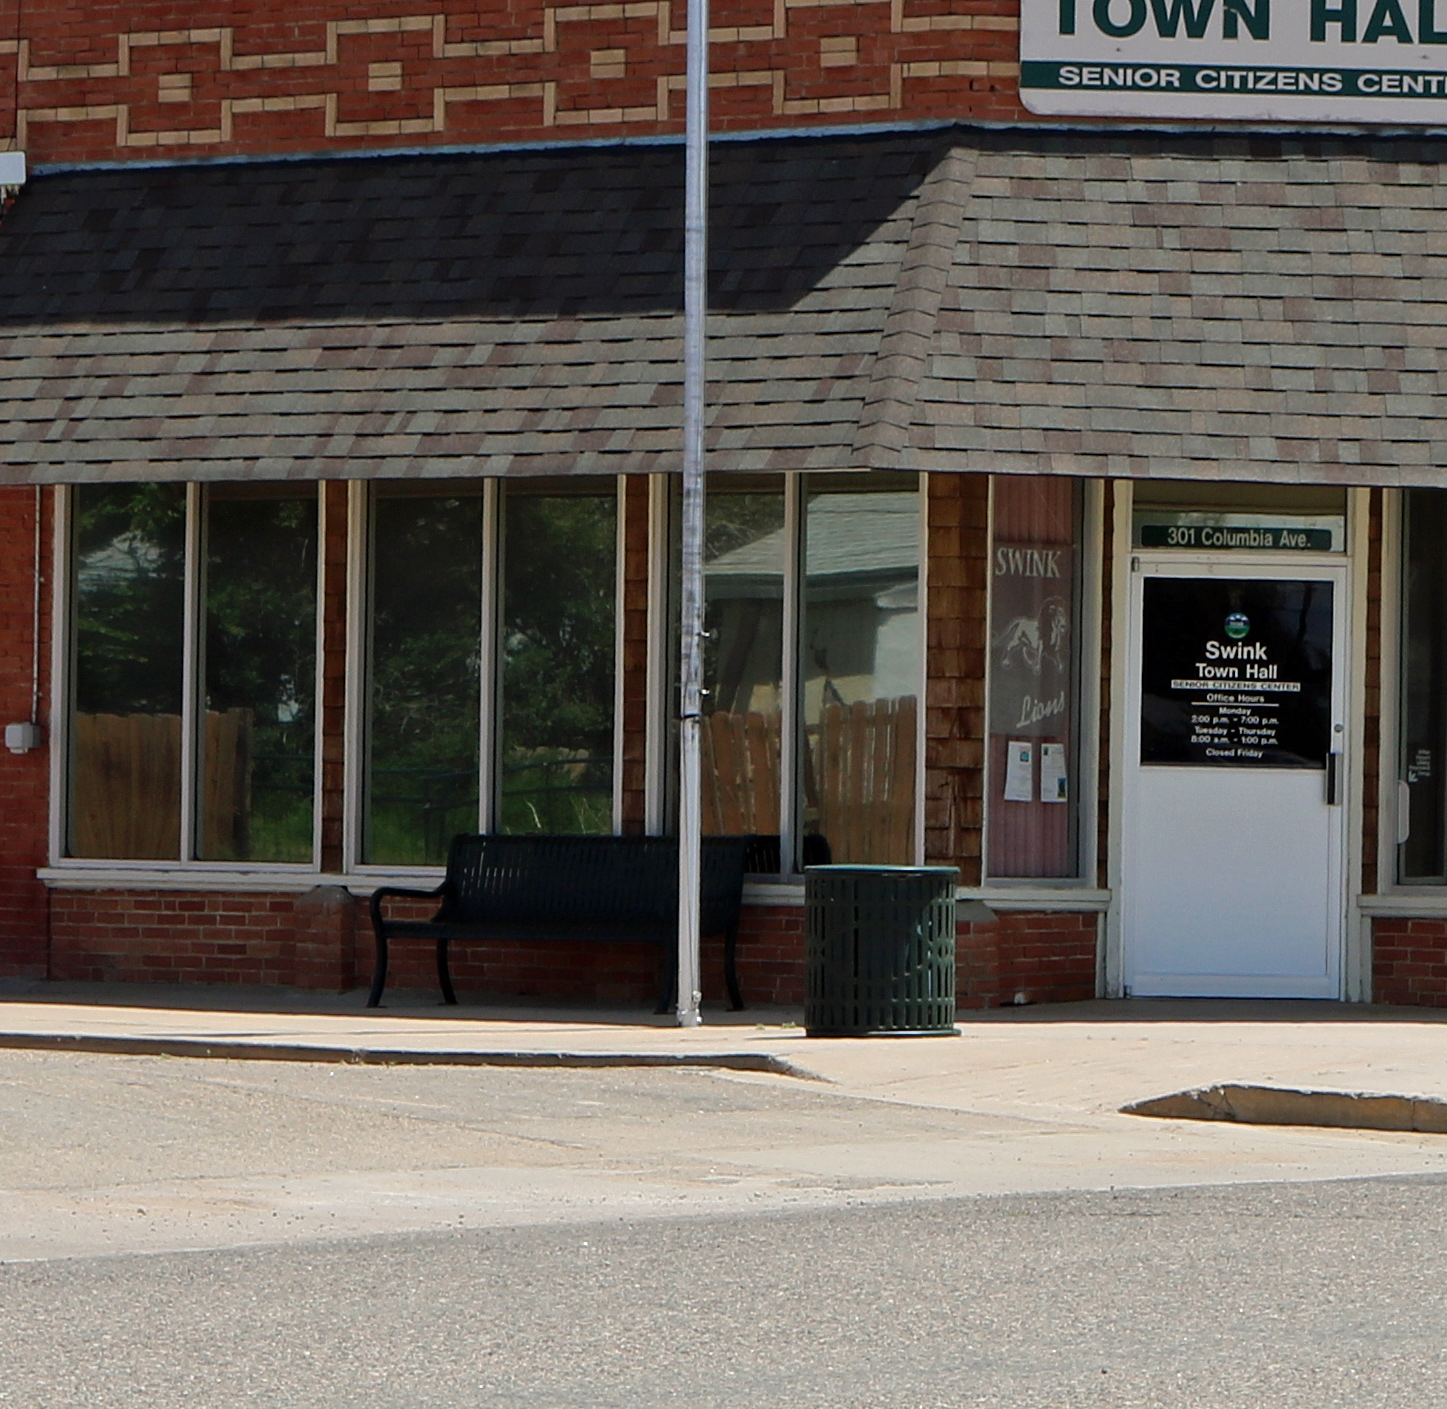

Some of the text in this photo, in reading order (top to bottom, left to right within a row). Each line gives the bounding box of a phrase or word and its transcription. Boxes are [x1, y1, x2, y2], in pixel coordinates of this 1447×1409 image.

[1058, 66, 1181, 88] SENIOR
[1195, 68, 1343, 92] CITIZENS
[1167, 527, 1311, 548] 301 Columbia Ave.
[995, 547, 1061, 579] SWINK
[1205, 640, 1268, 660] Swink
[1195, 662, 1278, 679] Town Hall
[1172, 680, 1299, 691] SENIOR CITIZENS CENTER
[1206, 693, 1265, 703] Office Hours
[1016, 691, 1065, 728] Lions
[1218, 707, 1252, 716] Monday
[1191, 715, 1210, 723] 2:00
[1241, 716, 1259, 724] 7:00
[1194, 726, 1228, 735] Tuesday
[1239, 727, 1276, 736] Thursday
[1206, 747, 1263, 758] Closed Friday
